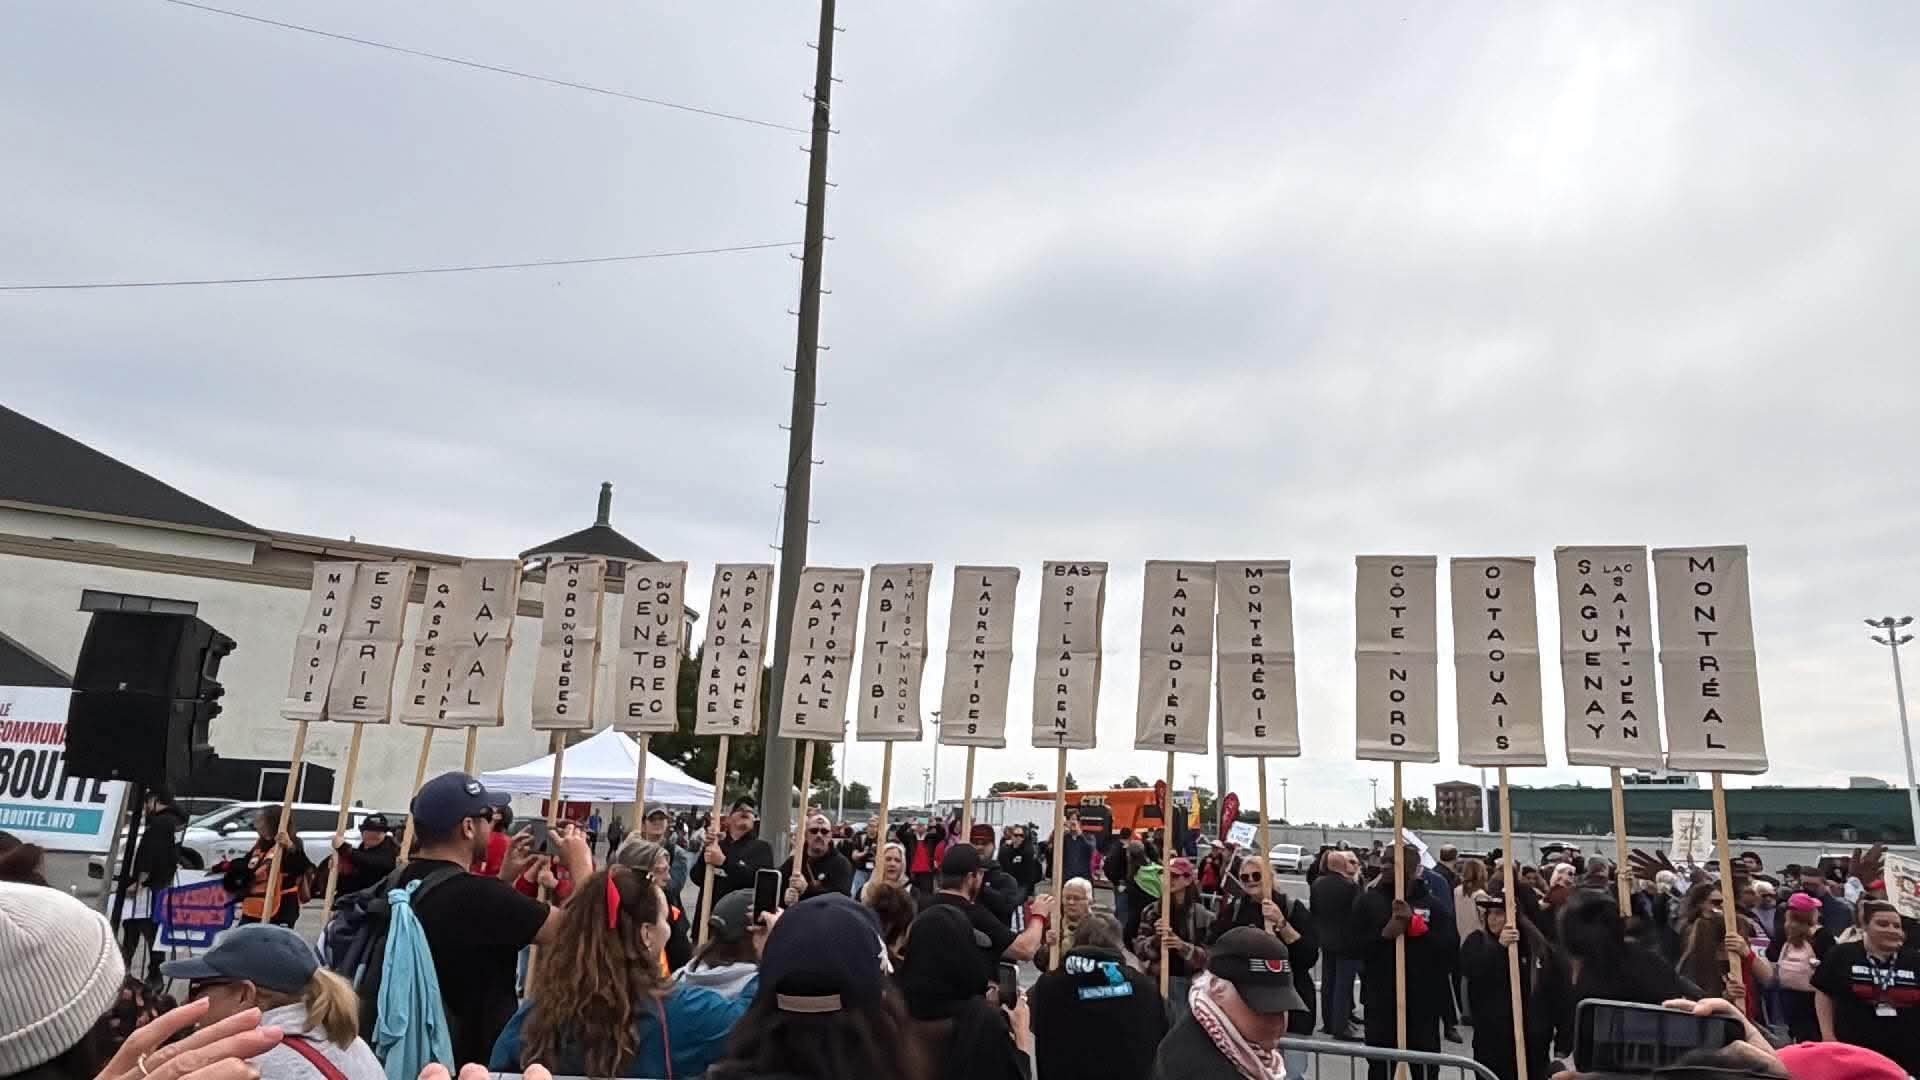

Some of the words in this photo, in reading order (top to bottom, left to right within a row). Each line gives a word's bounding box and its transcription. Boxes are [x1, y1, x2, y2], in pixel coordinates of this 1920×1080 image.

[304, 573, 341, 702] MAURICIE
[564, 563, 579, 617] NORD
[656, 581, 672, 589] DU
[1054, 564, 1092, 577] BAS
[1603, 563, 1632, 574] LAC
[352, 571, 391, 710] ESTRIE
[414, 583, 450, 705] GASPÉSIE
[468, 576, 495, 705] LAVAL
[556, 634, 574, 714] QUÉBEC
[628, 577, 651, 717] CENTRE
[649, 591, 670, 713] QUÉBEC
[731, 570, 758, 726] APPALACHES
[795, 582, 825, 725] CAPITALE
[818, 583, 845, 709] NATIONALE
[871, 578, 895, 719] ABITIBI
[967, 575, 992, 734] LAURENTIDES
[1053, 586, 1074, 744] ST-LAURENT
[1245, 567, 1266, 738] MONTÉRÉGIE
[1485, 566, 1509, 750] OUTAOUAIS
[1577, 559, 1605, 739] SAGUENAY
[1688, 556, 1726, 749] MONTRÉAL
